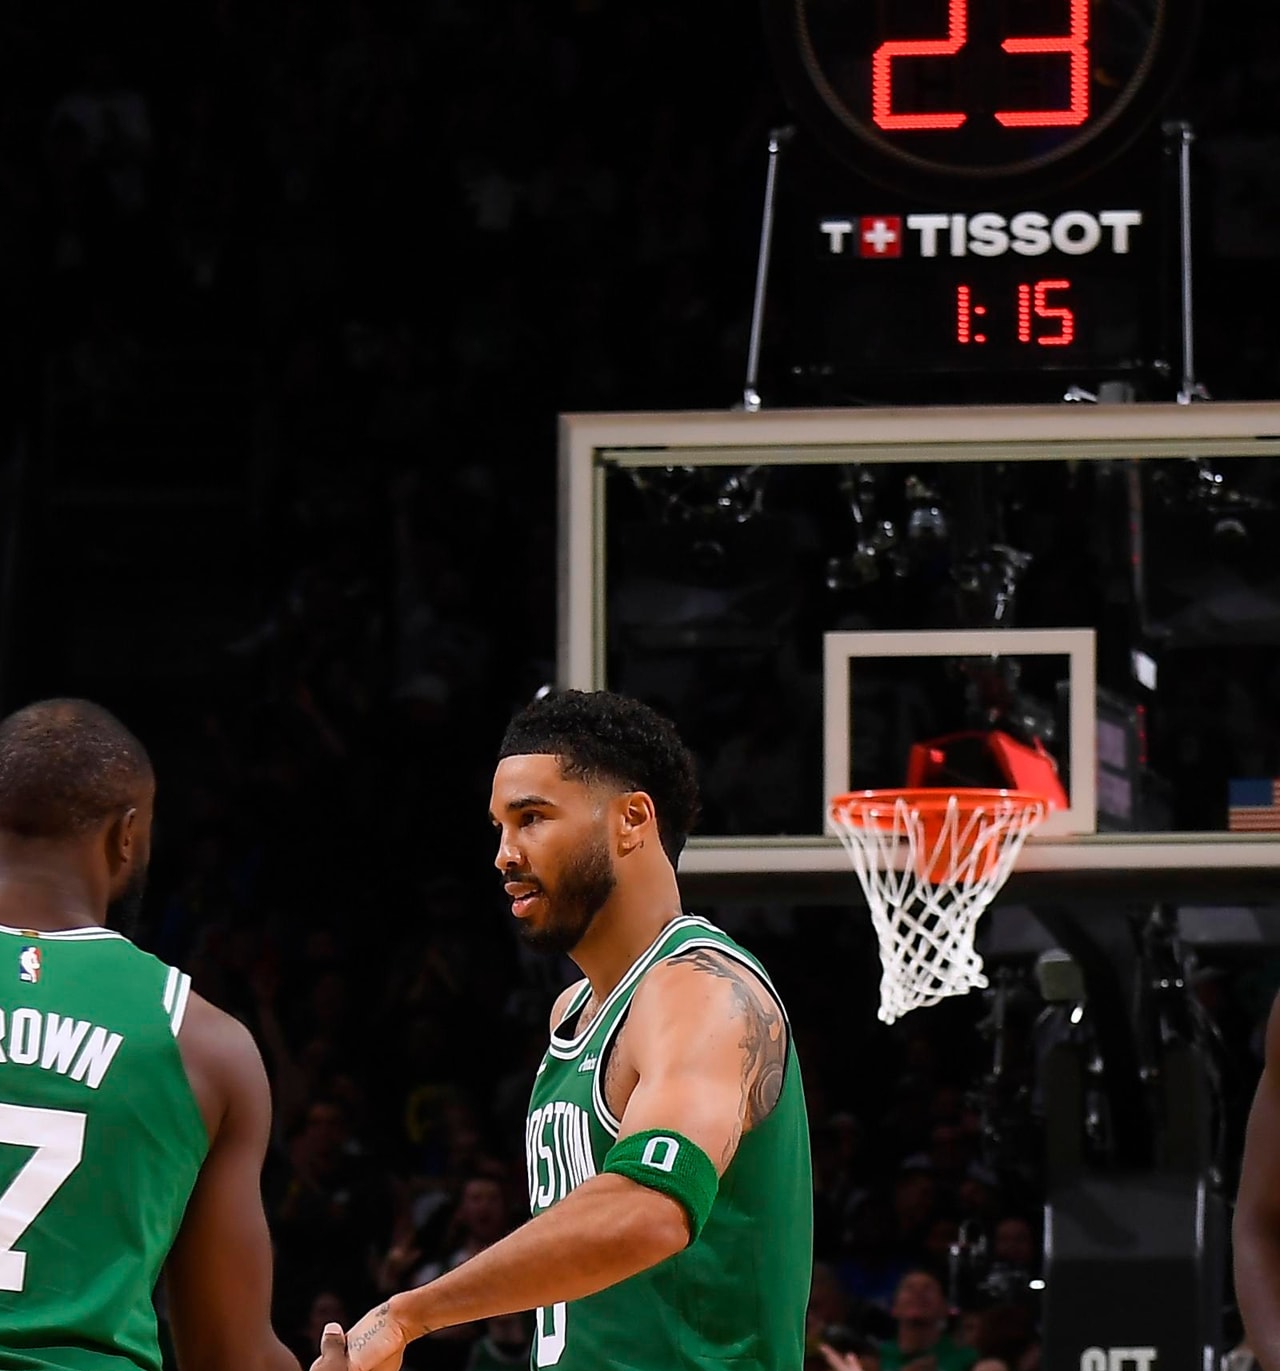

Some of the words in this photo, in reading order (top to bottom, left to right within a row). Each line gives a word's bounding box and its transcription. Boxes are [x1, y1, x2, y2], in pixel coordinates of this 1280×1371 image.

[872, 0, 1090, 130] 23
[907, 210, 1142, 257] TISSOT
[956, 280, 1075, 347] 1:15
[641, 1136, 680, 1172] 0
